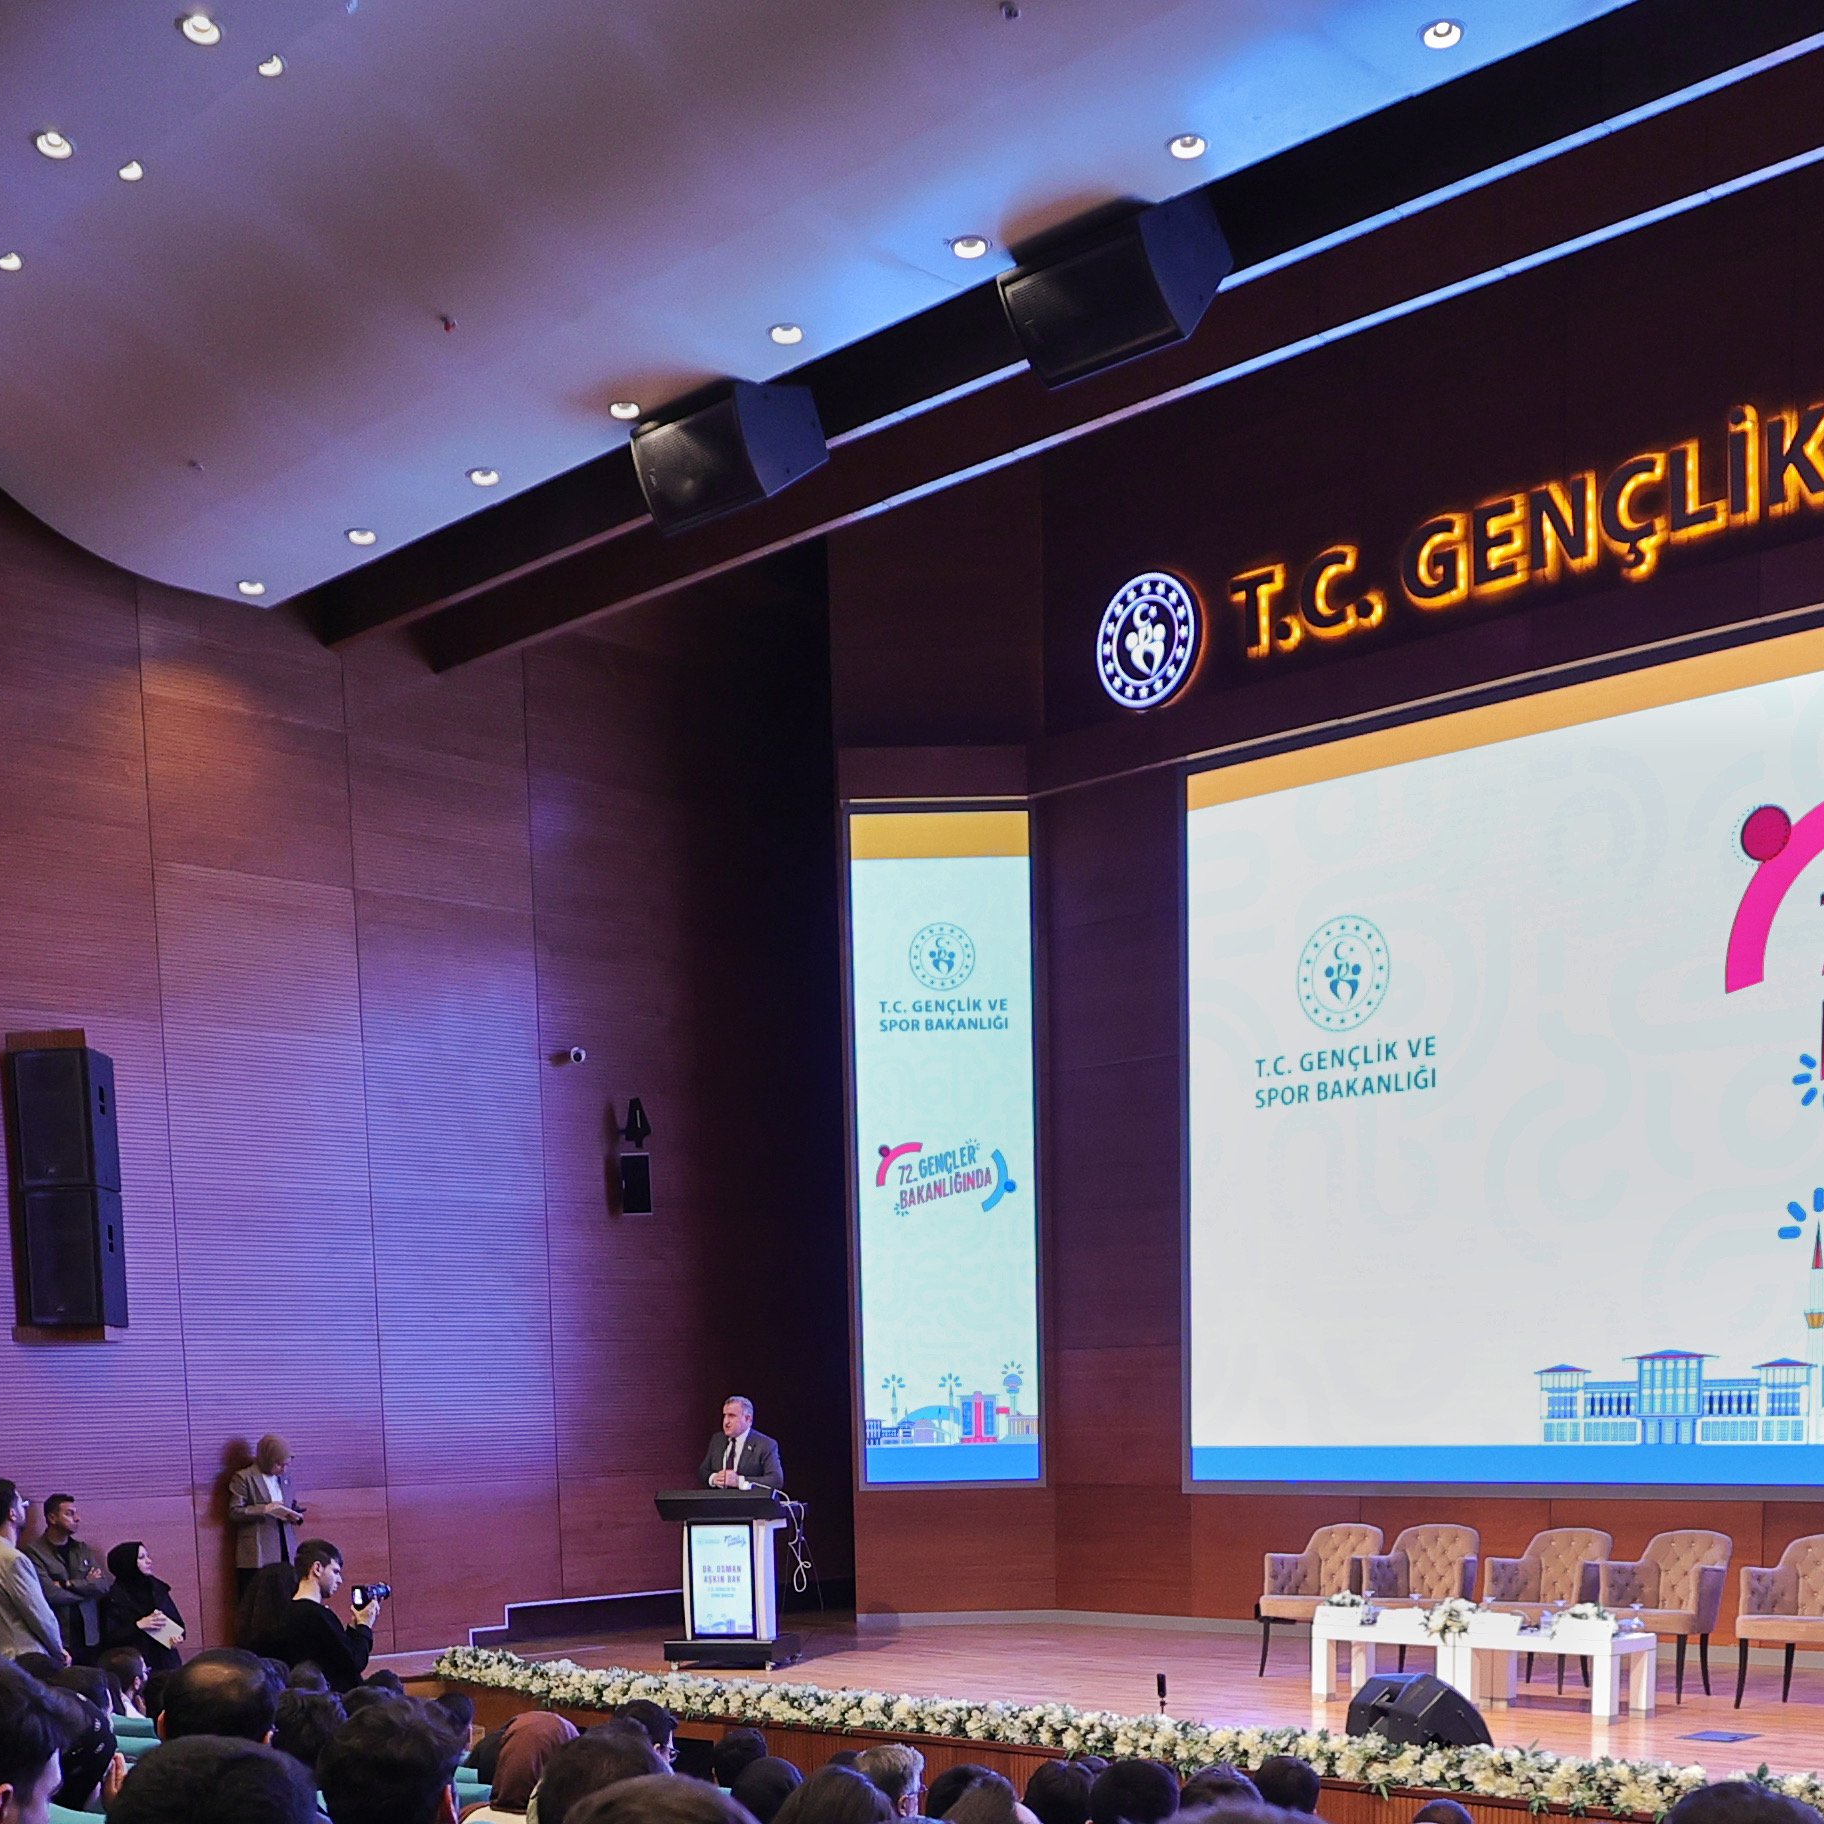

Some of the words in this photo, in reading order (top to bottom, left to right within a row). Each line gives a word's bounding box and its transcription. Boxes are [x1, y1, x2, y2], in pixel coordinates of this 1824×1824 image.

[1230, 545, 1385, 658] T.C.
[879, 1000, 907, 1013] T.C.
[912, 996, 982, 1015] GENÇLİK
[988, 998, 1008, 1011] VE
[880, 1019, 920, 1032] SPOR
[925, 1015, 1008, 1031] BAKANLIĞI
[1255, 1056, 1292, 1078] T.C.
[1300, 1038, 1398, 1071] GENÇLİK
[1408, 1036, 1436, 1058] VE
[1255, 1085, 1308, 1108] SPOR
[1317, 1064, 1436, 1101] BAKANLIĞI
[918, 1145, 977, 1178] GENÇLER
